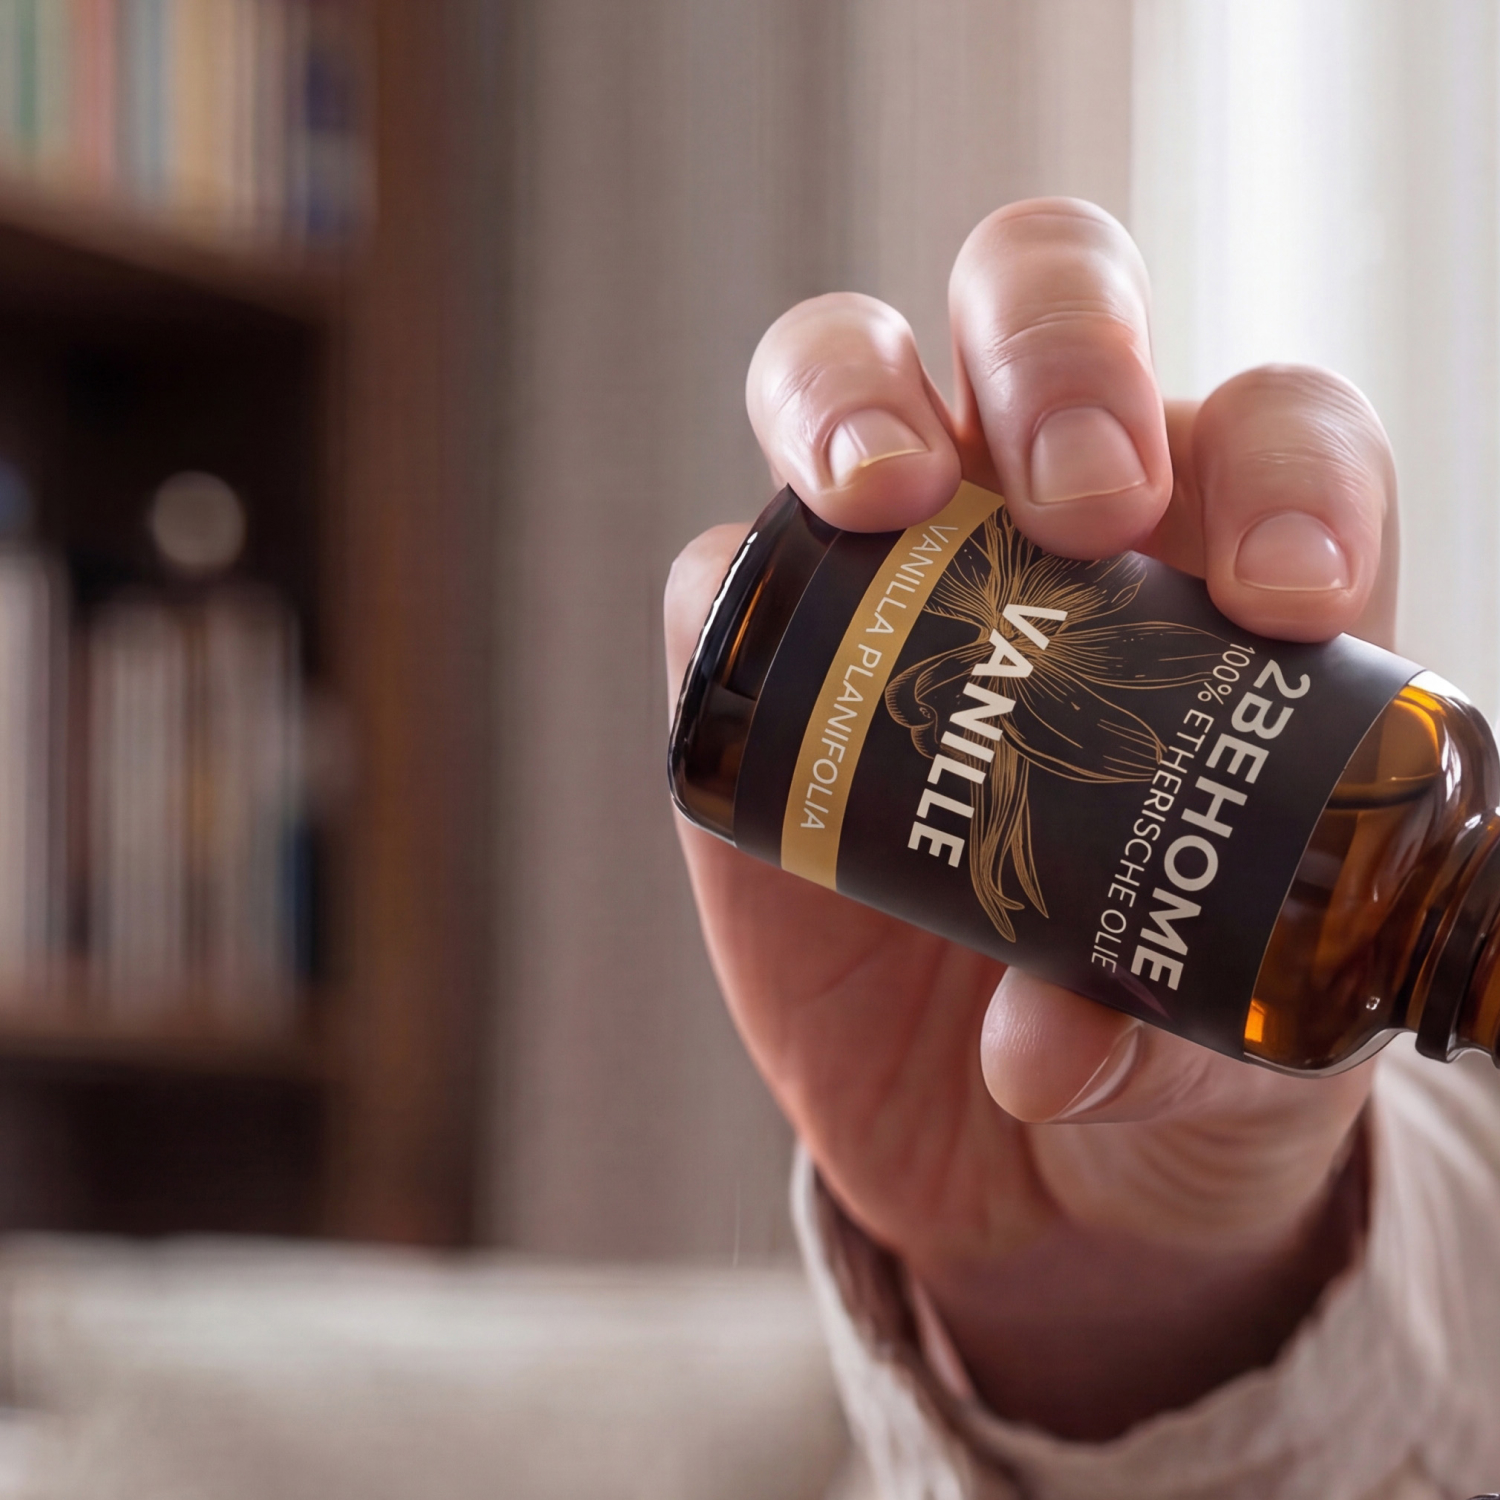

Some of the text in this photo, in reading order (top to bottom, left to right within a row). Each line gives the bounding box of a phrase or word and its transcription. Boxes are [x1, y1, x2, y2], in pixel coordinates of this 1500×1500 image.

[800, 525, 959, 829] VANILLA PLANIFOLIA
[908, 604, 1068, 868] VANILLE
[1091, 643, 1256, 973] 100% ETHERISCHE OLIE
[1130, 659, 1311, 991] 2BEHOME
